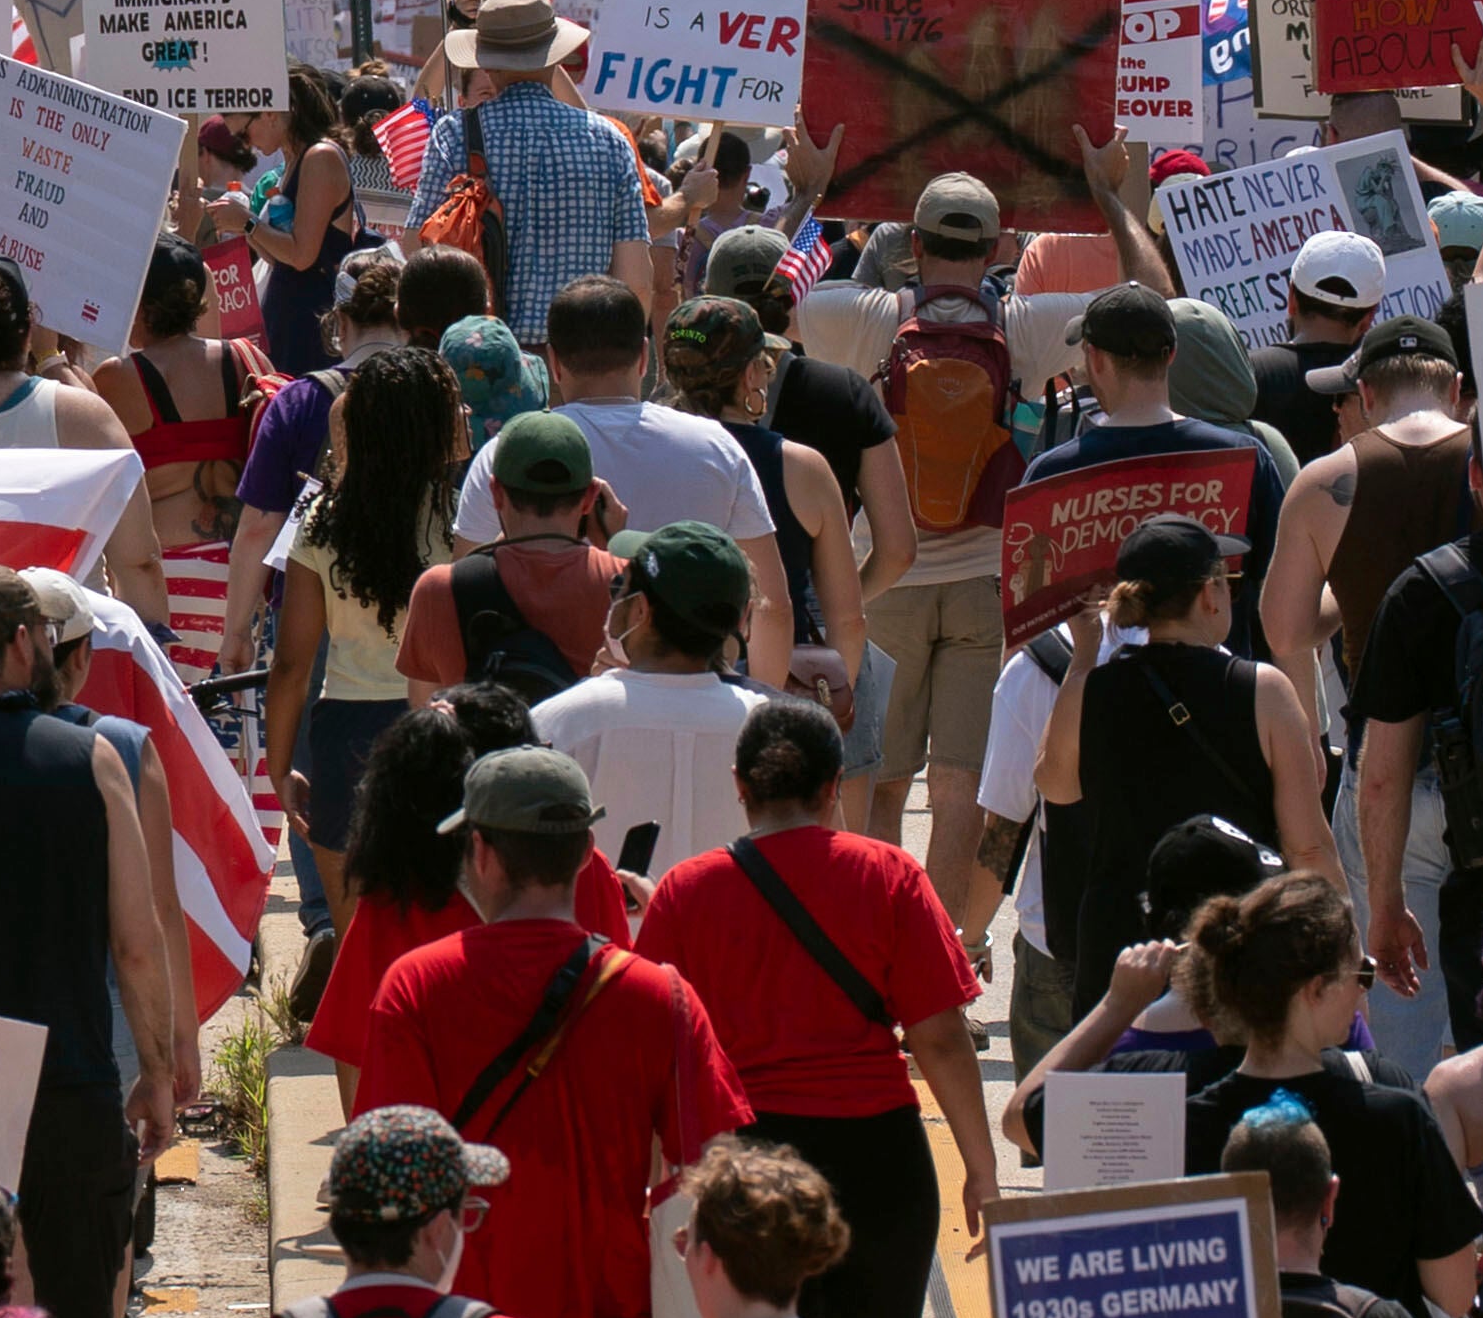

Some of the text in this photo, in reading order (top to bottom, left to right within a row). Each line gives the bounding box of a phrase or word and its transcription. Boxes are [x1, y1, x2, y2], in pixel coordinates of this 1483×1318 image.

[99, 9, 247, 33] MAKE AMERICA
[645, 6, 704, 31] IS A
[883, 17, 944, 42] 1776
[1122, 56, 1146, 70] the
[1332, 27, 1467, 78] ABOUT
[168, 88, 273, 108] ICE TERROR
[594, 51, 783, 108] FIGHT FOR
[9, 97, 111, 150] IS THE ONLY
[21, 138, 73, 174] WASTE
[16, 170, 65, 205] FRAUD
[1167, 162, 1327, 233] HATE NEVER
[18, 202, 49, 229] AND
[1183, 204, 1347, 277] MADE AMERICA
[1051, 479, 1223, 527] NURSES FOR
[1015, 1238, 1227, 1284] WE ARE LIVING
[1102, 1279, 1239, 1318] GERMANY
